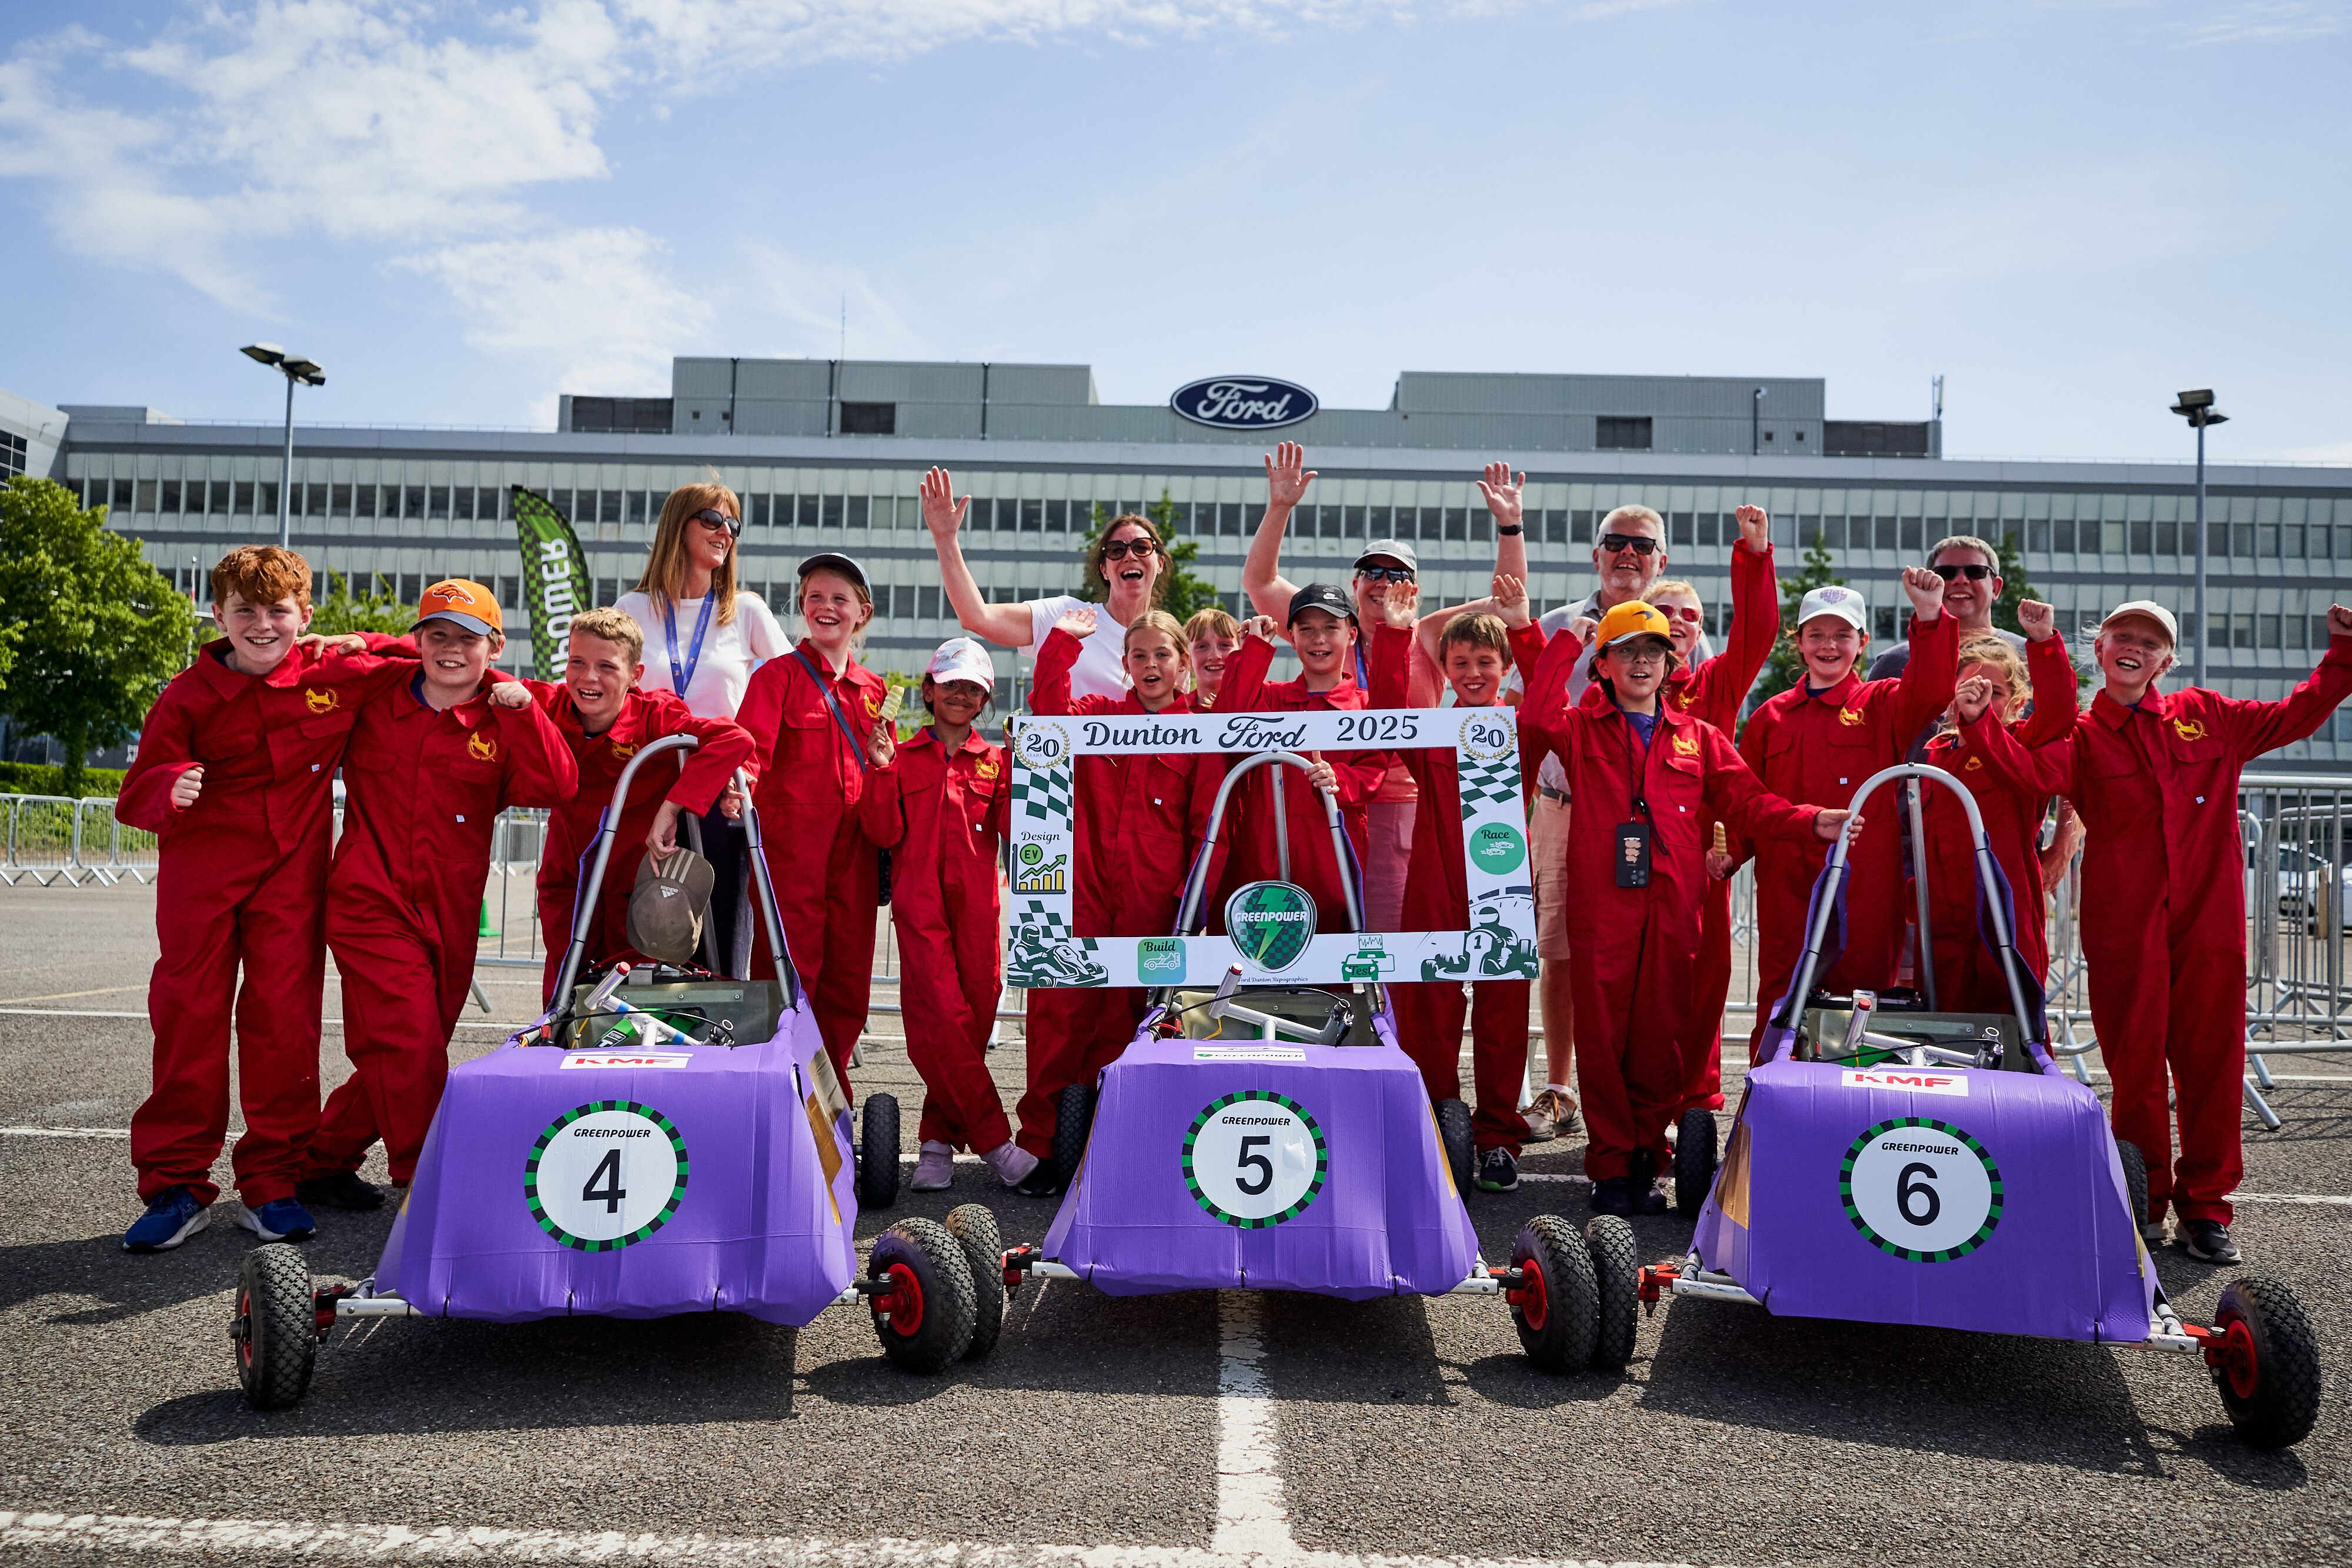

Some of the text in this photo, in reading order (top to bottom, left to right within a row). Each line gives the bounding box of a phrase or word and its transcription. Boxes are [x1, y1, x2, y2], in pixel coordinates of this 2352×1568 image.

[1197, 381, 1292, 420] Ford
[1083, 716, 1419, 748] Dunton Ford 2025
[1471, 724, 1505, 747] 20
[1026, 734, 1059, 757] 20
[1021, 831, 1061, 844] Design
[1481, 829, 1510, 840] Race
[1024, 850, 1038, 859] EV
[1235, 911, 1307, 922] GREENPOWER
[1144, 941, 1176, 952] Build
[1474, 935, 1481, 949] 1
[1348, 965, 1373, 975] Test
[1855, 1074, 1953, 1087] KMF
[1222, 1116, 1291, 1126] GREENPOWER
[573, 1128, 651, 1138] GREENPOWER
[1882, 1142, 1959, 1156] GREENPOWER
[1235, 1136, 1273, 1196] 5
[582, 1149, 626, 1213] 4
[1896, 1162, 1940, 1226] 6
